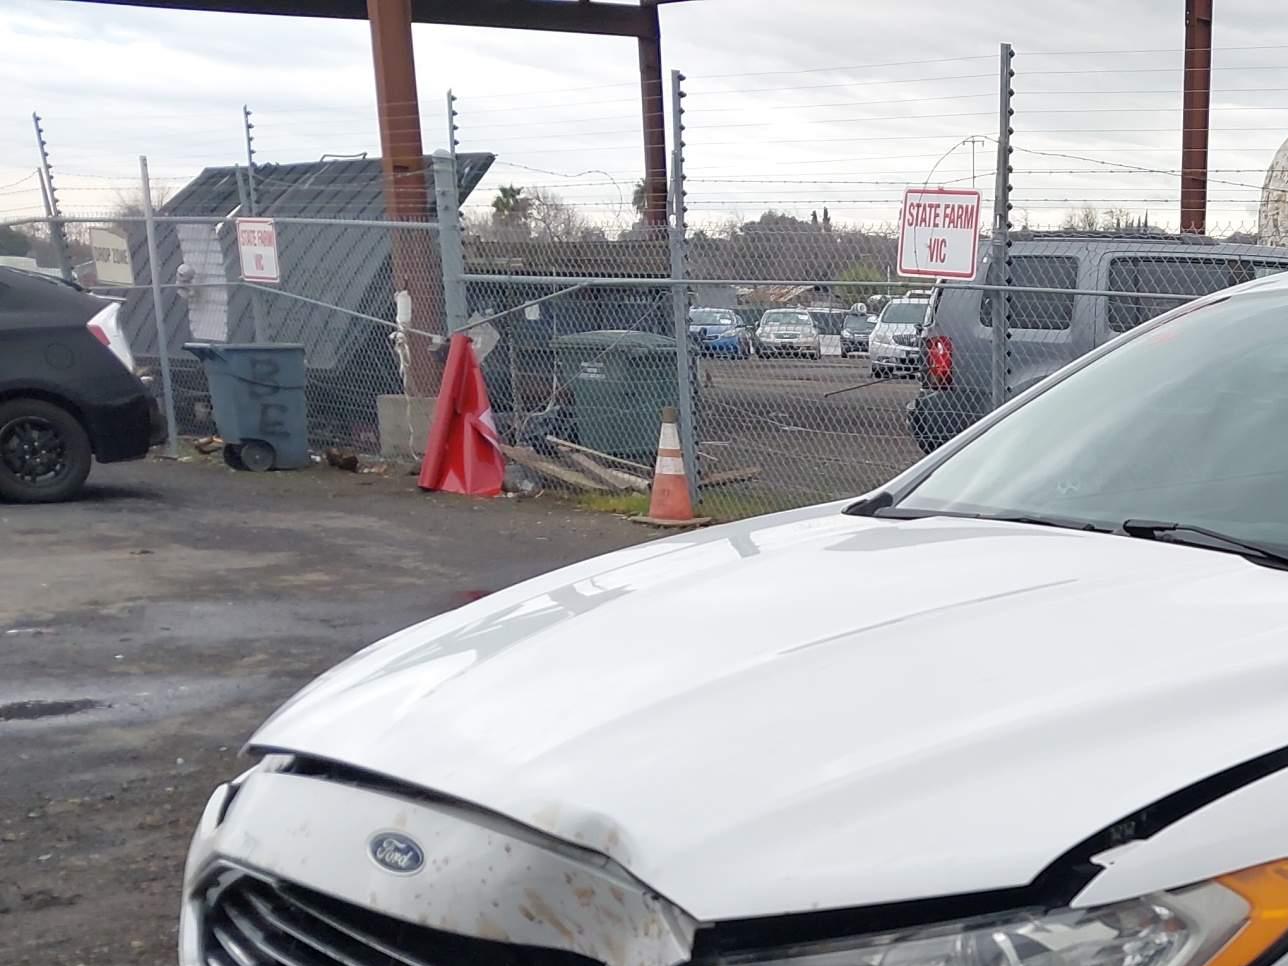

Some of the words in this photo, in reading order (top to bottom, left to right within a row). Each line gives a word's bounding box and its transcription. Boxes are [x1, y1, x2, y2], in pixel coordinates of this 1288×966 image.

[907, 202, 940, 228] STATE
[943, 203, 975, 230] FARM
[928, 237, 947, 263] VIC
[376, 838, 414, 868] Ford
